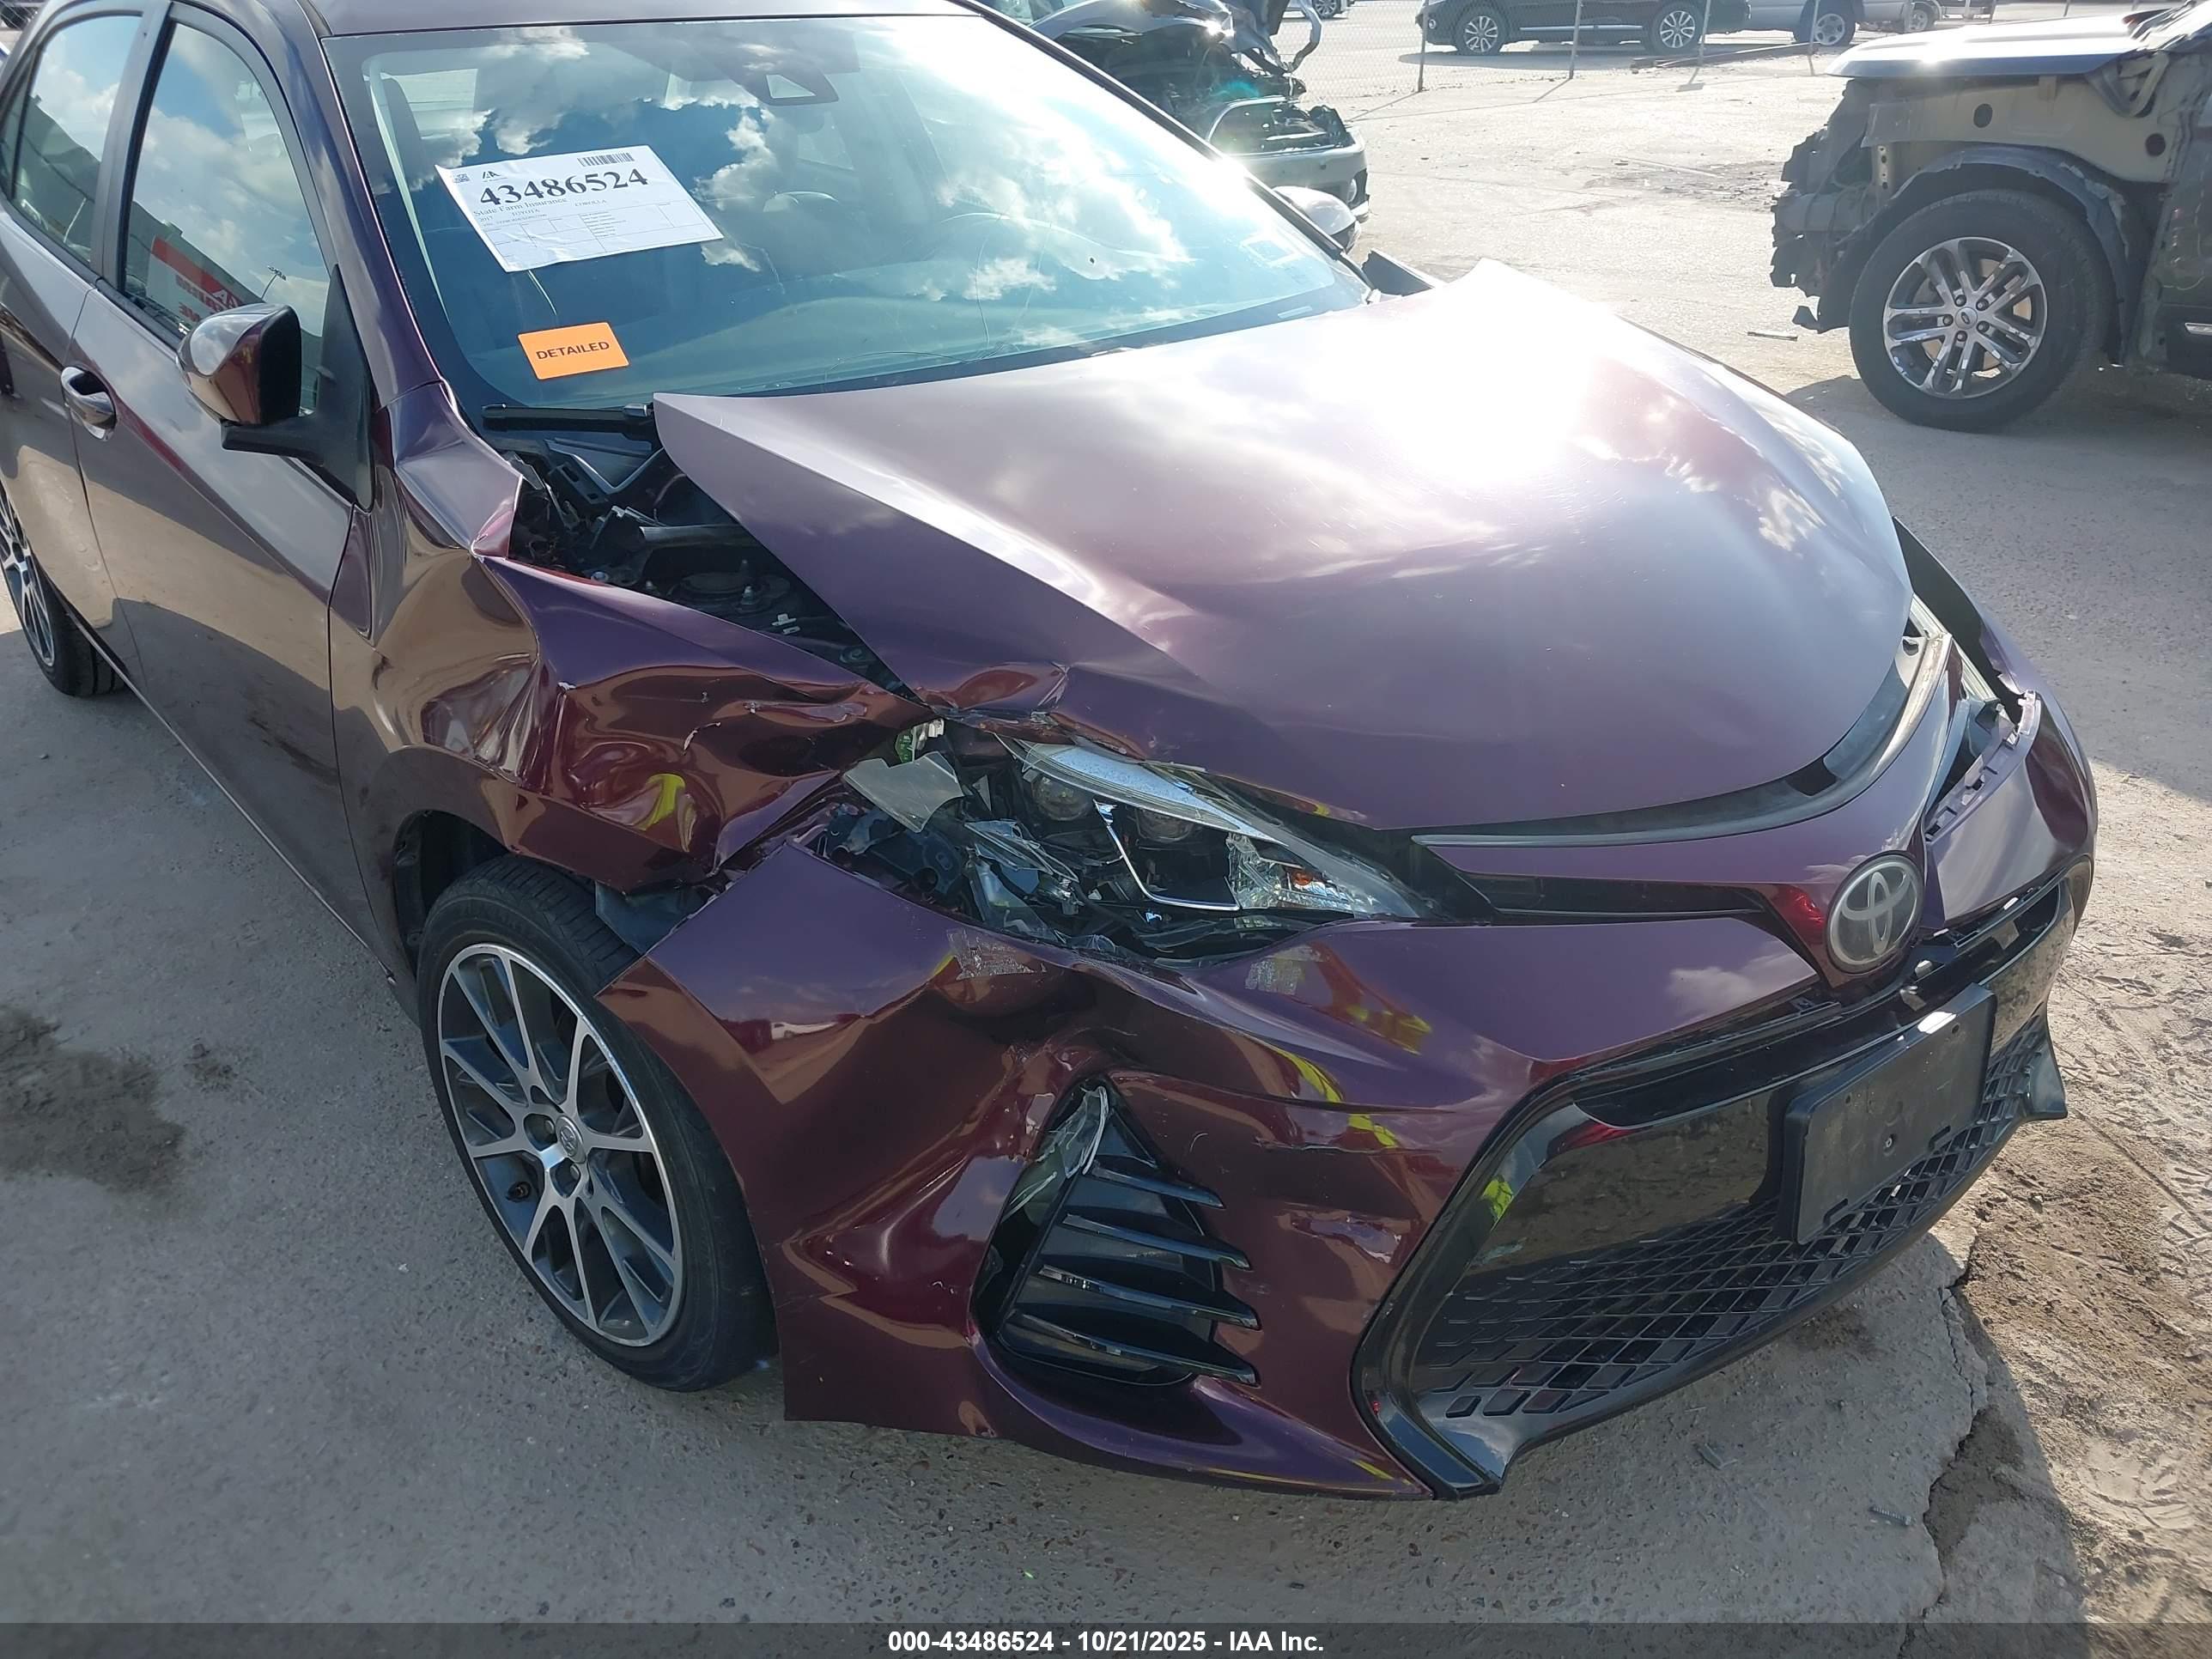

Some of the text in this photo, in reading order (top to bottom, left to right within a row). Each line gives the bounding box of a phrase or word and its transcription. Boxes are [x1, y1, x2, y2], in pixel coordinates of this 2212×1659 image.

[480, 167, 648, 206] 43486524
[473, 198, 568, 216] State Farm Insurance
[536, 341, 610, 360] DETAILED
